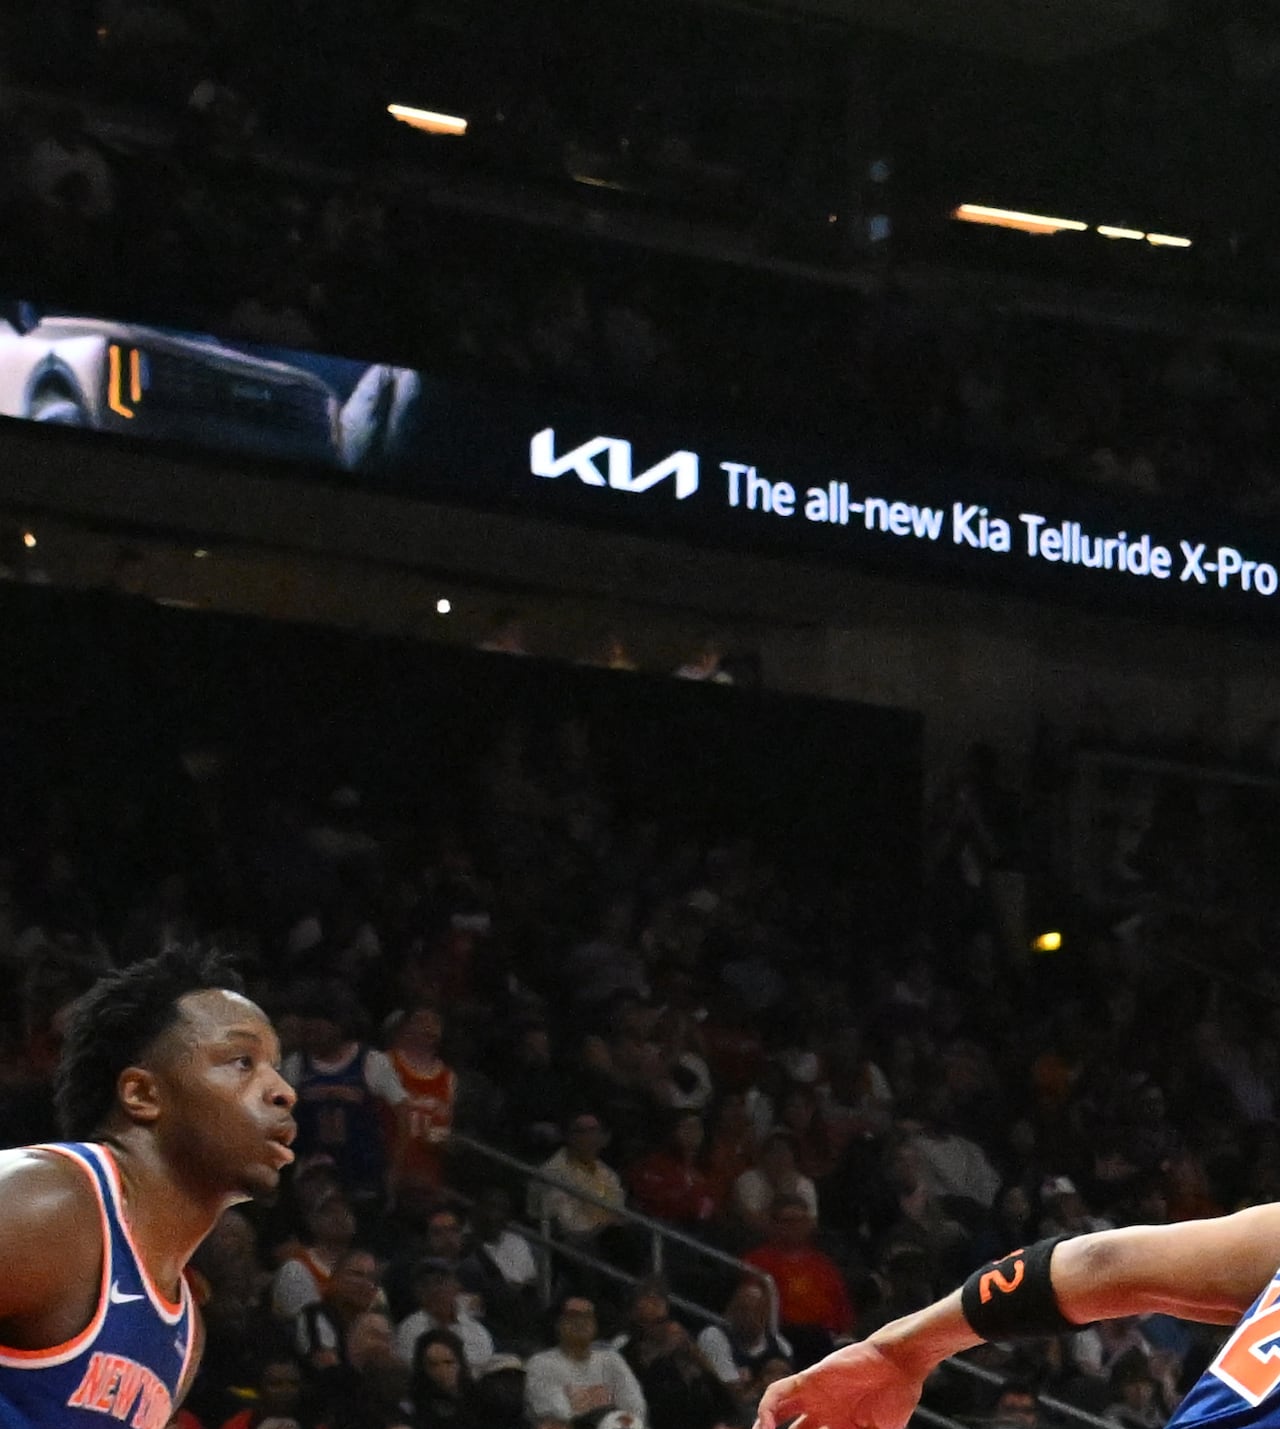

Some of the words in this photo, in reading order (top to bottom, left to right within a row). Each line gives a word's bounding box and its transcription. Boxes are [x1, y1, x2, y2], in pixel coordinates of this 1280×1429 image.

[530, 427, 699, 500] KIA
[719, 461, 796, 517] The
[804, 480, 944, 541] all-new
[952, 502, 1011, 552] Kia
[1018, 513, 1172, 579] Telluride
[1179, 540, 1278, 596] X-Pro
